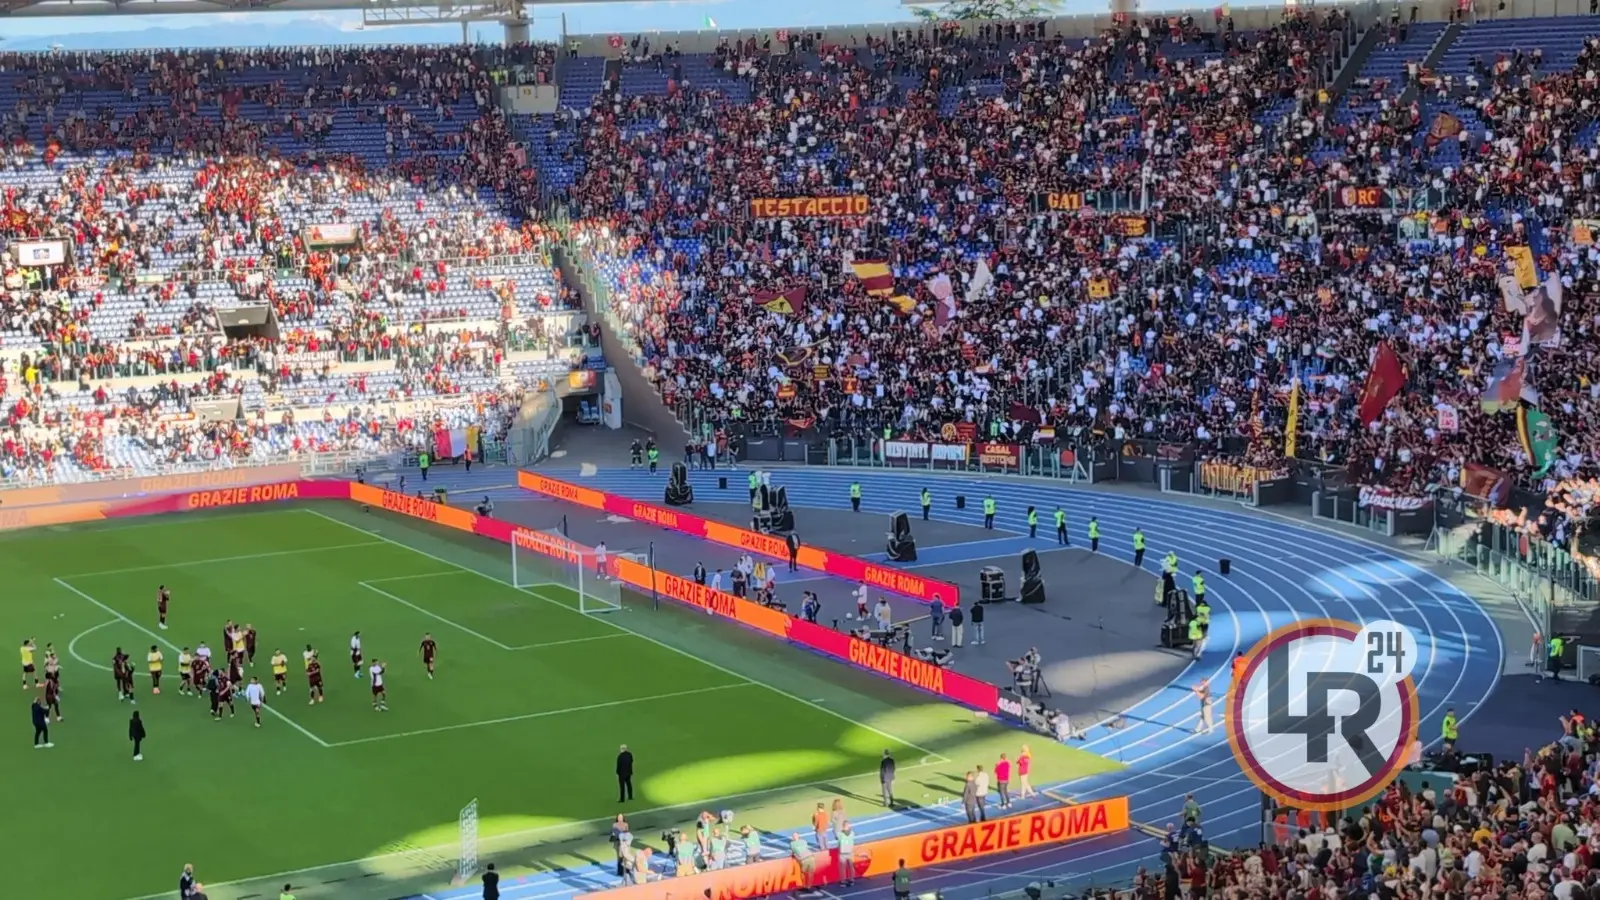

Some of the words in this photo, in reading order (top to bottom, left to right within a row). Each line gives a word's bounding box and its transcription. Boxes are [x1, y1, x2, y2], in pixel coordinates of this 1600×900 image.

[751, 196, 869, 216] TESTACCIO
[1357, 189, 1376, 205] RC
[985, 444, 1012, 455] CASAL
[188, 487, 248, 508] GRAZIE
[250, 482, 299, 502] ROMA
[539, 479, 560, 498] GRAZIE
[561, 485, 579, 500] ROMA
[381, 490, 411, 514] GRAZIE
[412, 498, 437, 520] ROMA
[633, 503, 657, 524] GRAZIE
[657, 508, 678, 528] ROMA
[740, 531, 767, 552] GRAZIE
[864, 566, 897, 589] GRAZIE
[898, 575, 925, 597] ROMA
[664, 575, 701, 607] GRAZIE
[704, 589, 737, 618] ROMA
[849, 638, 899, 678] GRAZIE
[901, 654, 944, 694] ROMA
[920, 818, 1022, 863] GRAZIE
[1029, 804, 1109, 843] ROMA
